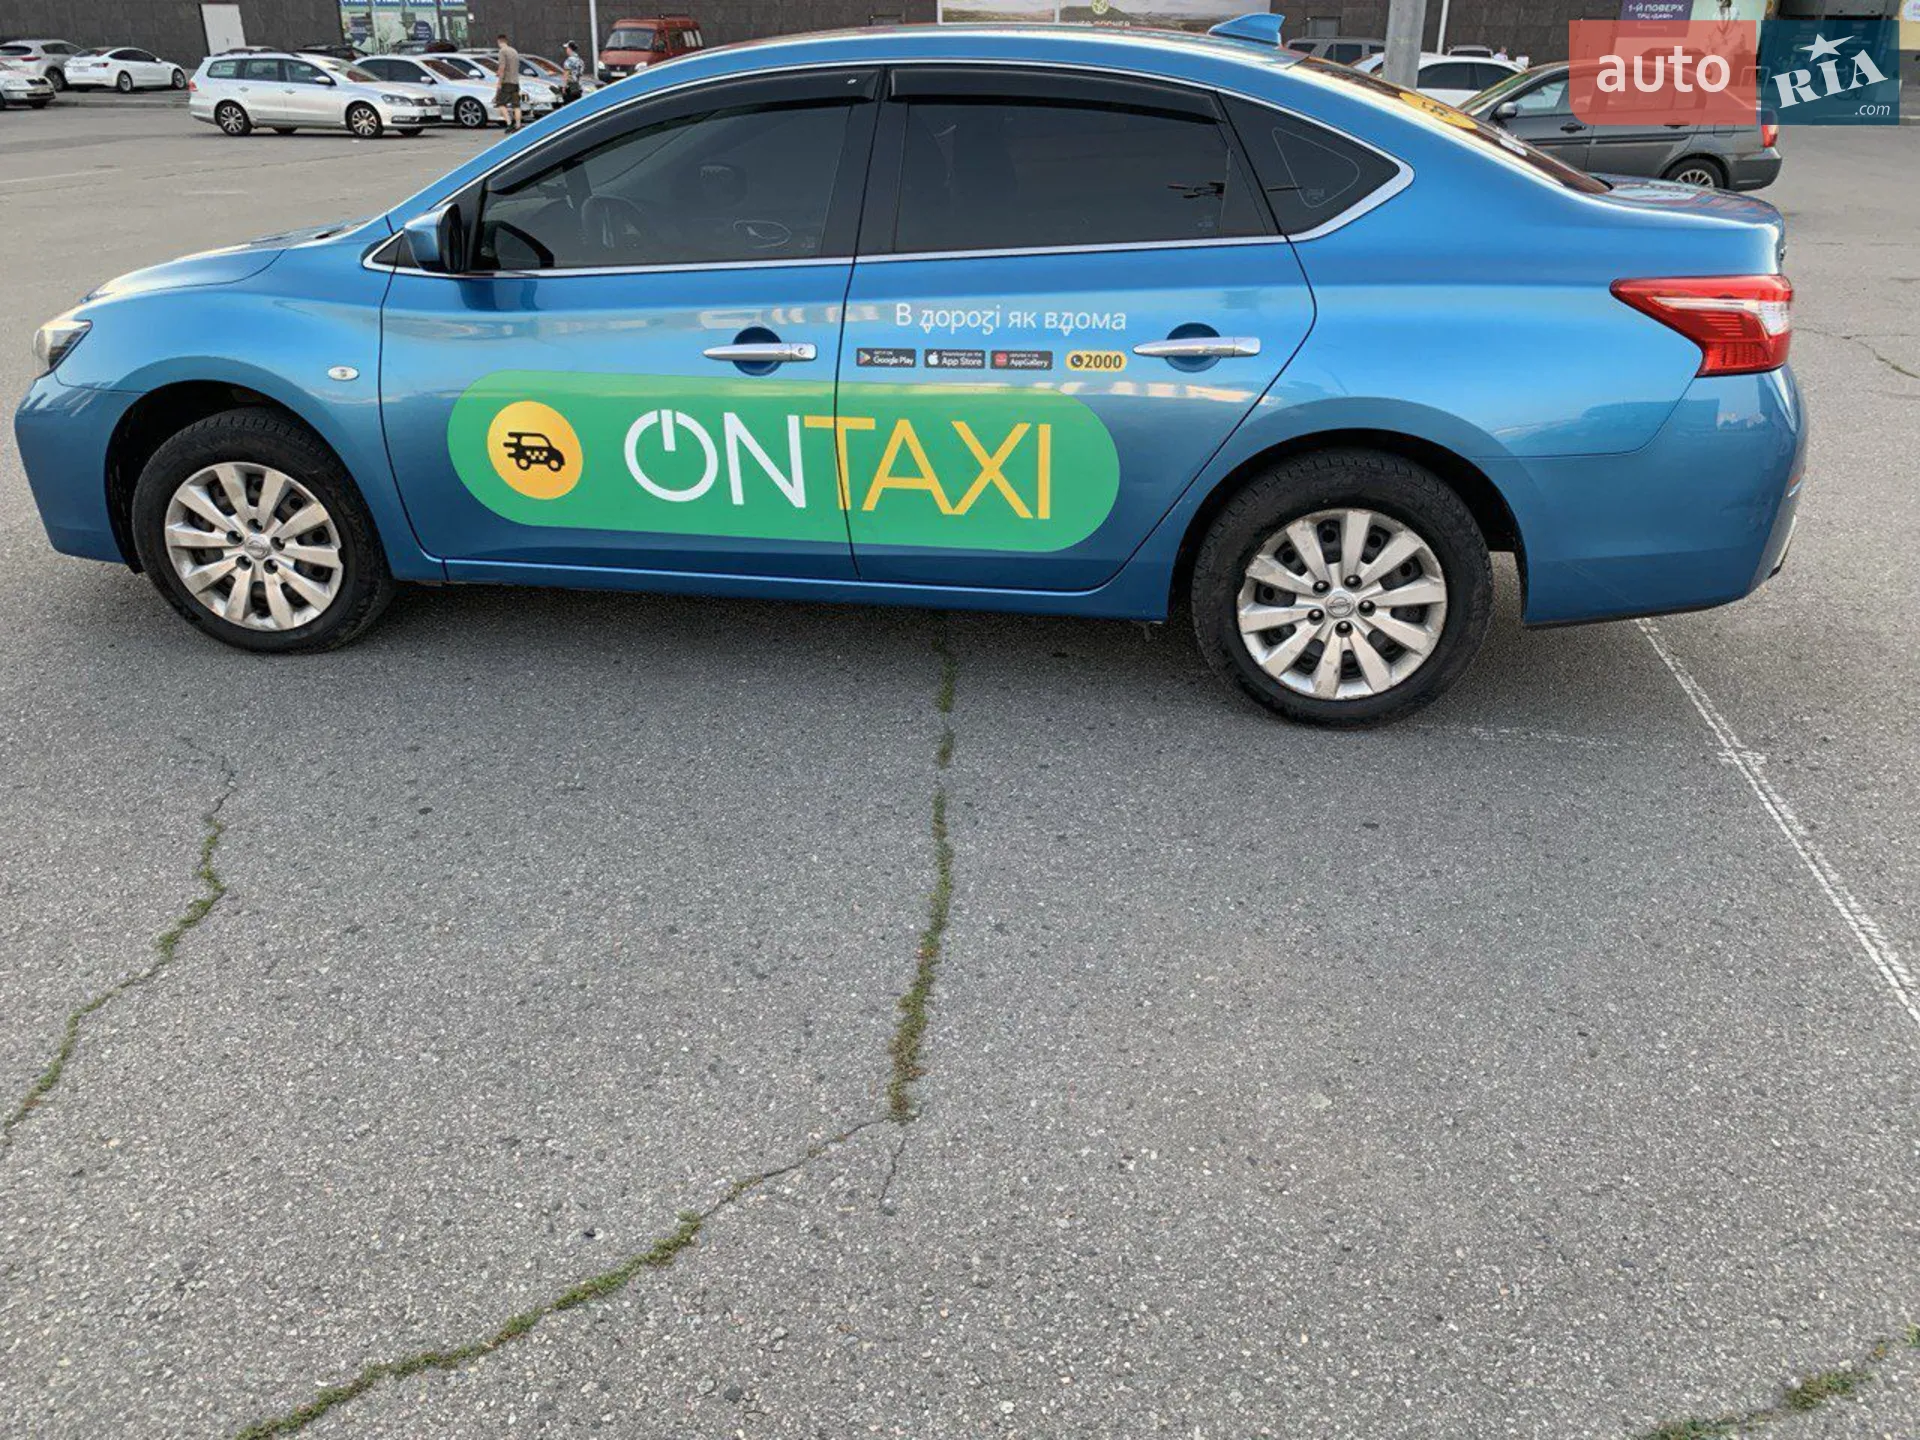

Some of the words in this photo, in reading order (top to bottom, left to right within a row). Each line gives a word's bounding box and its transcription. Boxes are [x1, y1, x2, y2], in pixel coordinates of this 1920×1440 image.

[895, 303, 913, 327] В
[1007, 312, 1037, 329] як
[1044, 311, 1127, 336] вдома
[873, 356, 899, 365] Google
[899, 356, 914, 366] Play
[942, 357, 959, 367] App
[959, 357, 982, 366] Store
[1084, 354, 1122, 369] 2000
